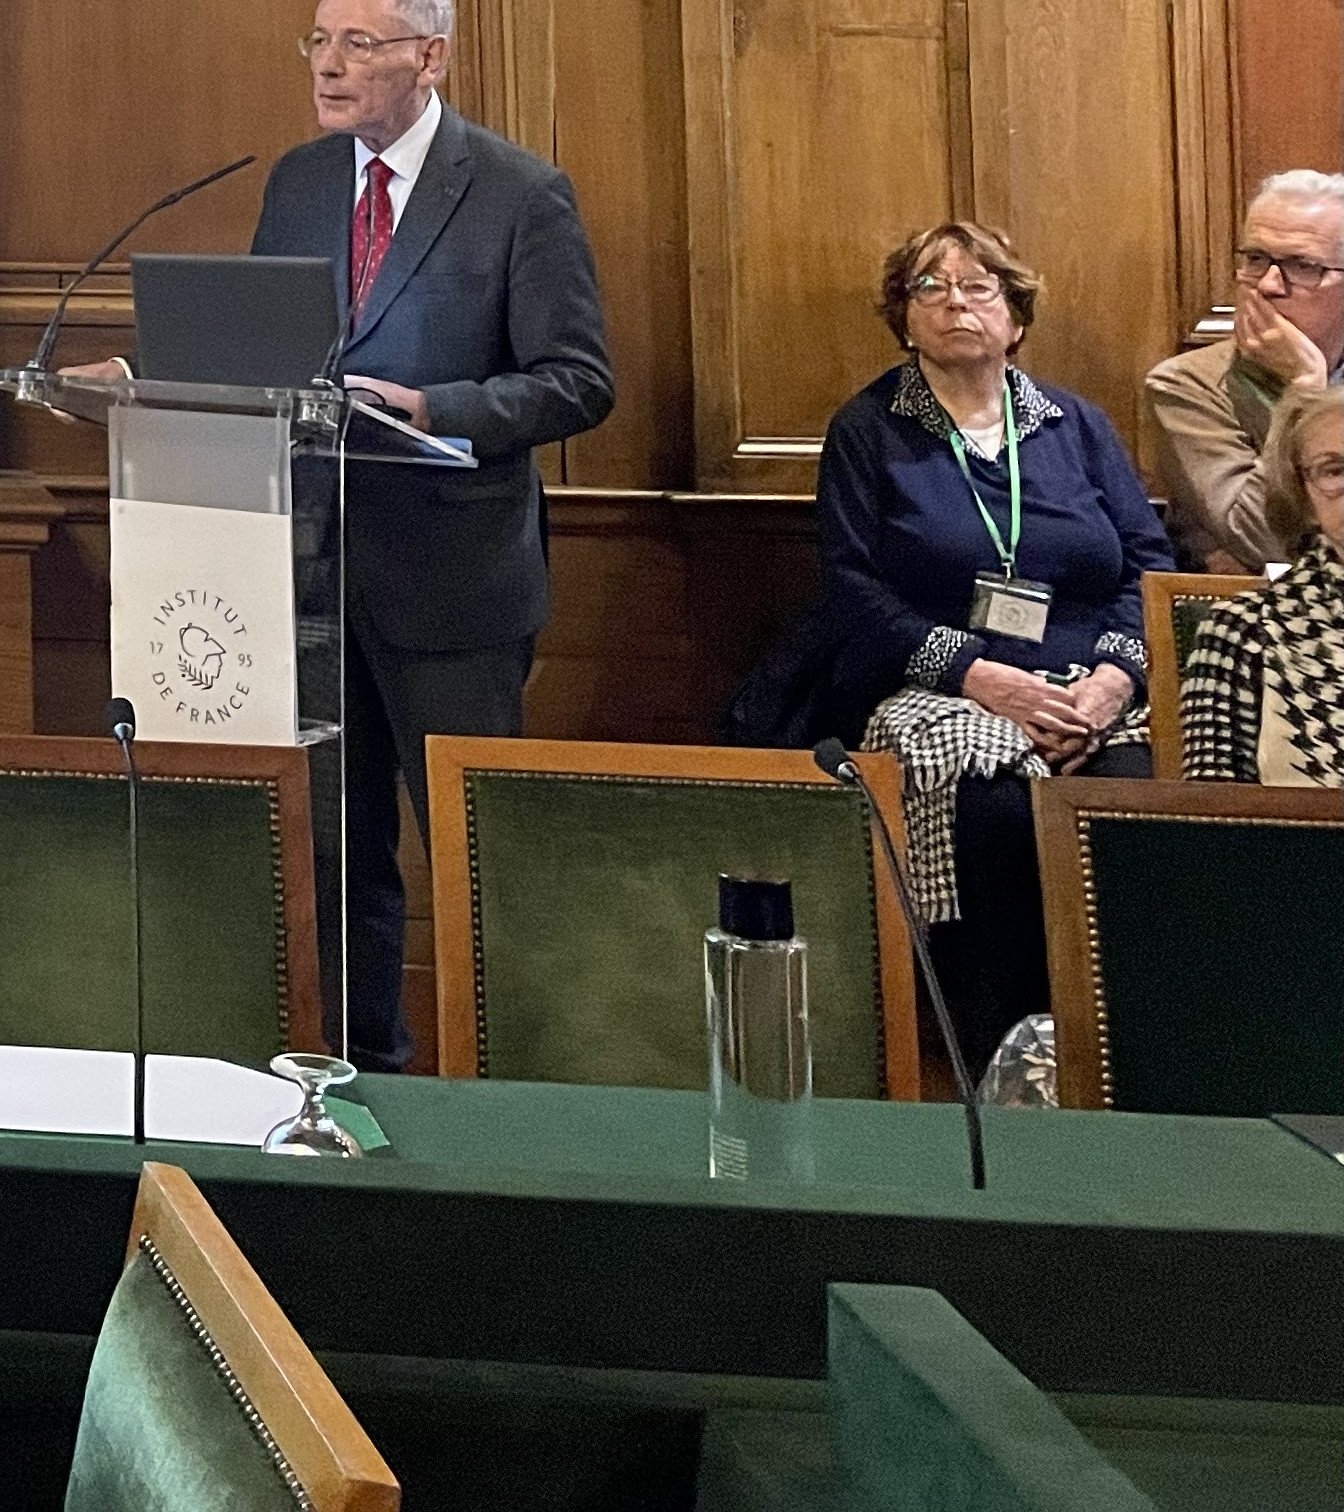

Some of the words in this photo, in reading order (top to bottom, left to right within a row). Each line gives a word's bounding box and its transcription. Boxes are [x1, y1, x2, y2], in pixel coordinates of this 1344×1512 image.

[152, 588, 248, 636] INSTITUT
[149, 640, 164, 655] 17
[237, 652, 253, 668] 95
[152, 671, 174, 701] DE
[175, 681, 250, 725] FRANCE
